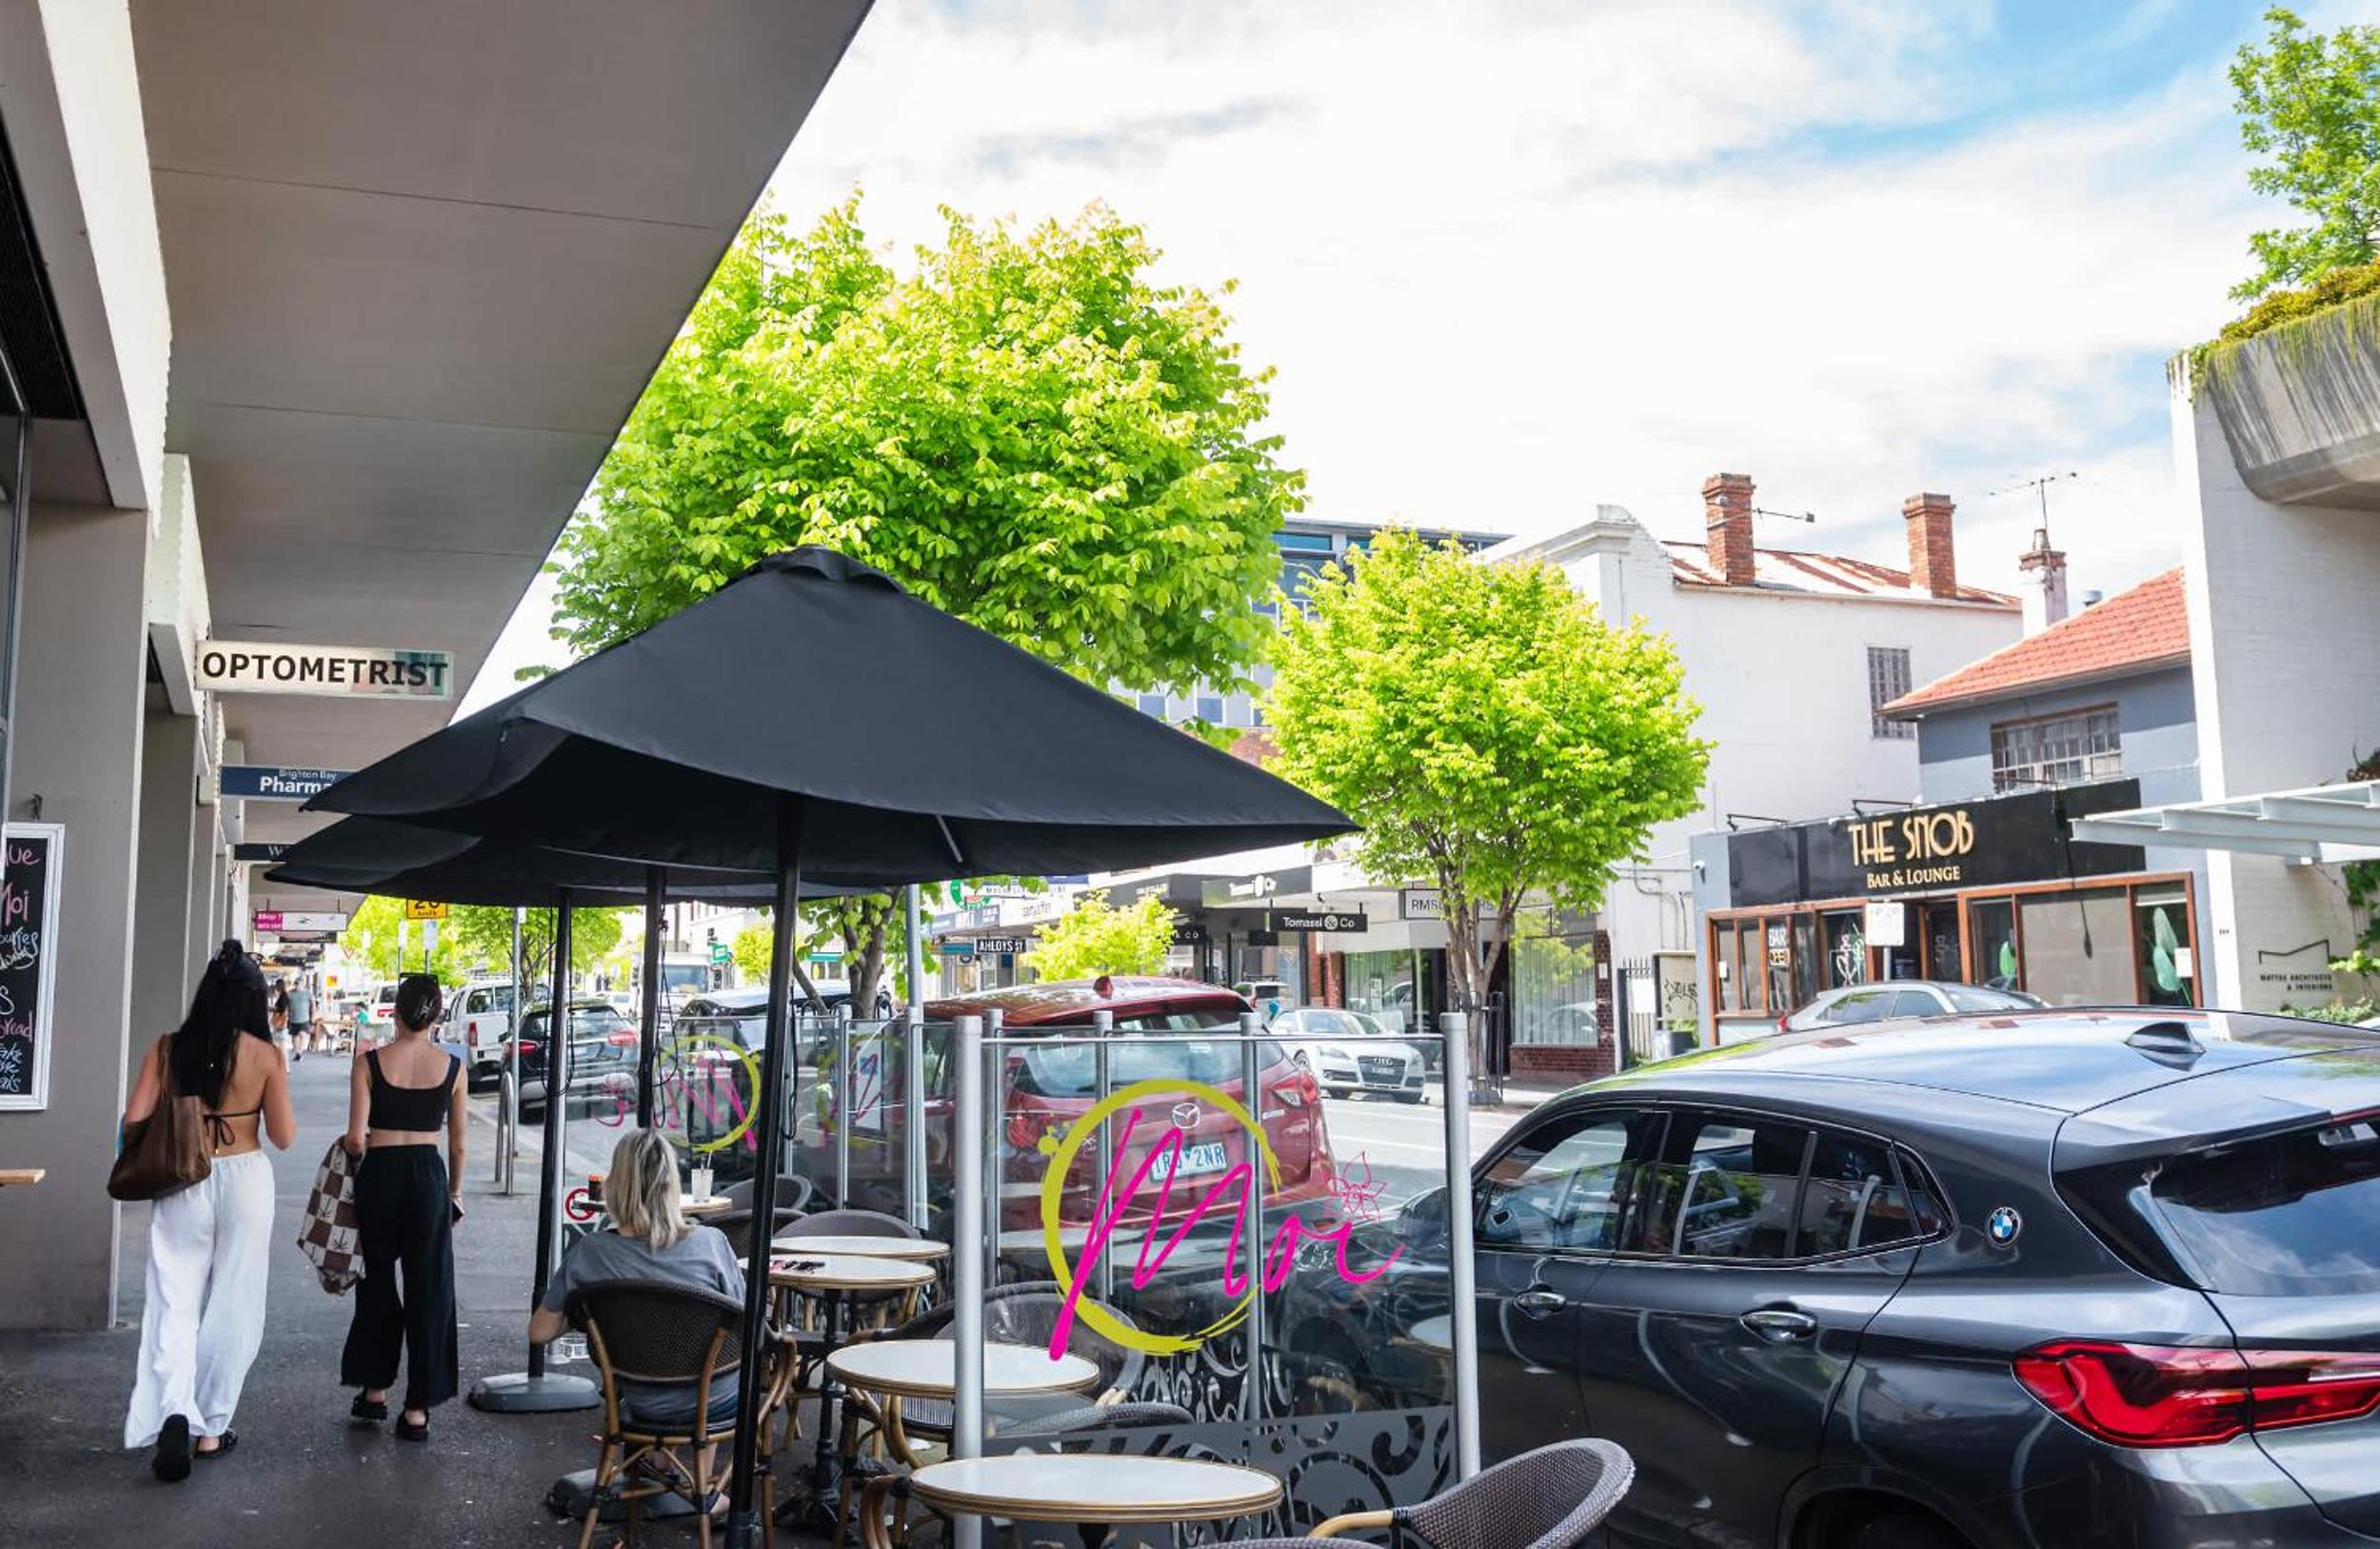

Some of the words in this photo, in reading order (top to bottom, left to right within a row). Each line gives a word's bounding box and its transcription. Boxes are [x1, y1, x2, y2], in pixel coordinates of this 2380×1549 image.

[202, 651, 447, 686] OPTOMETRIST
[1848, 820, 1895, 866] THE
[1903, 810, 1974, 860] SNOB
[1867, 873, 1891, 888] BAR
[1893, 870, 1904, 885] &
[1907, 865, 1961, 884] LOUNGE
[1339, 917, 1356, 928] Co
